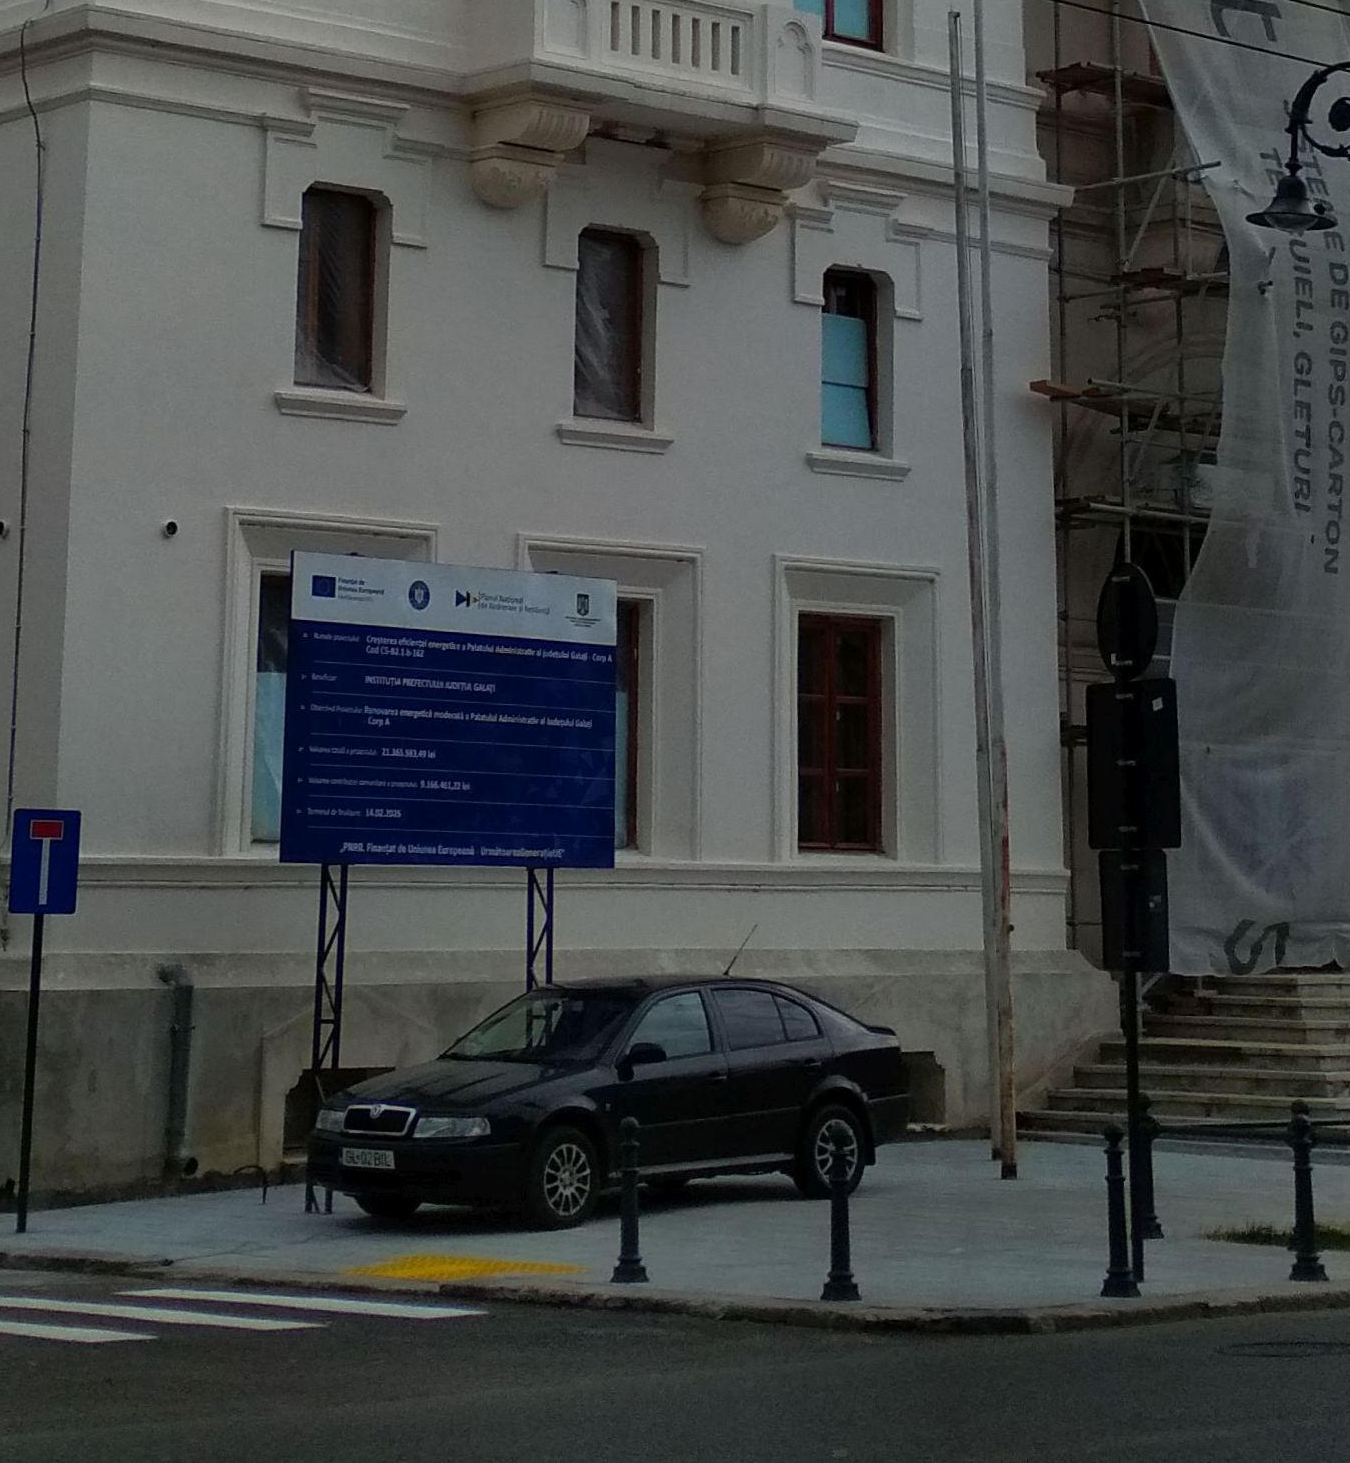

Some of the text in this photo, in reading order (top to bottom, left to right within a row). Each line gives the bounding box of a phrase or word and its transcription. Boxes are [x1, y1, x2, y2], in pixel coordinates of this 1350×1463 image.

[1258, 147, 1315, 515] TEUIELI, GLETURI
[1329, 260, 1350, 316] DE
[1323, 318, 1350, 576] GIPS-CARTON
